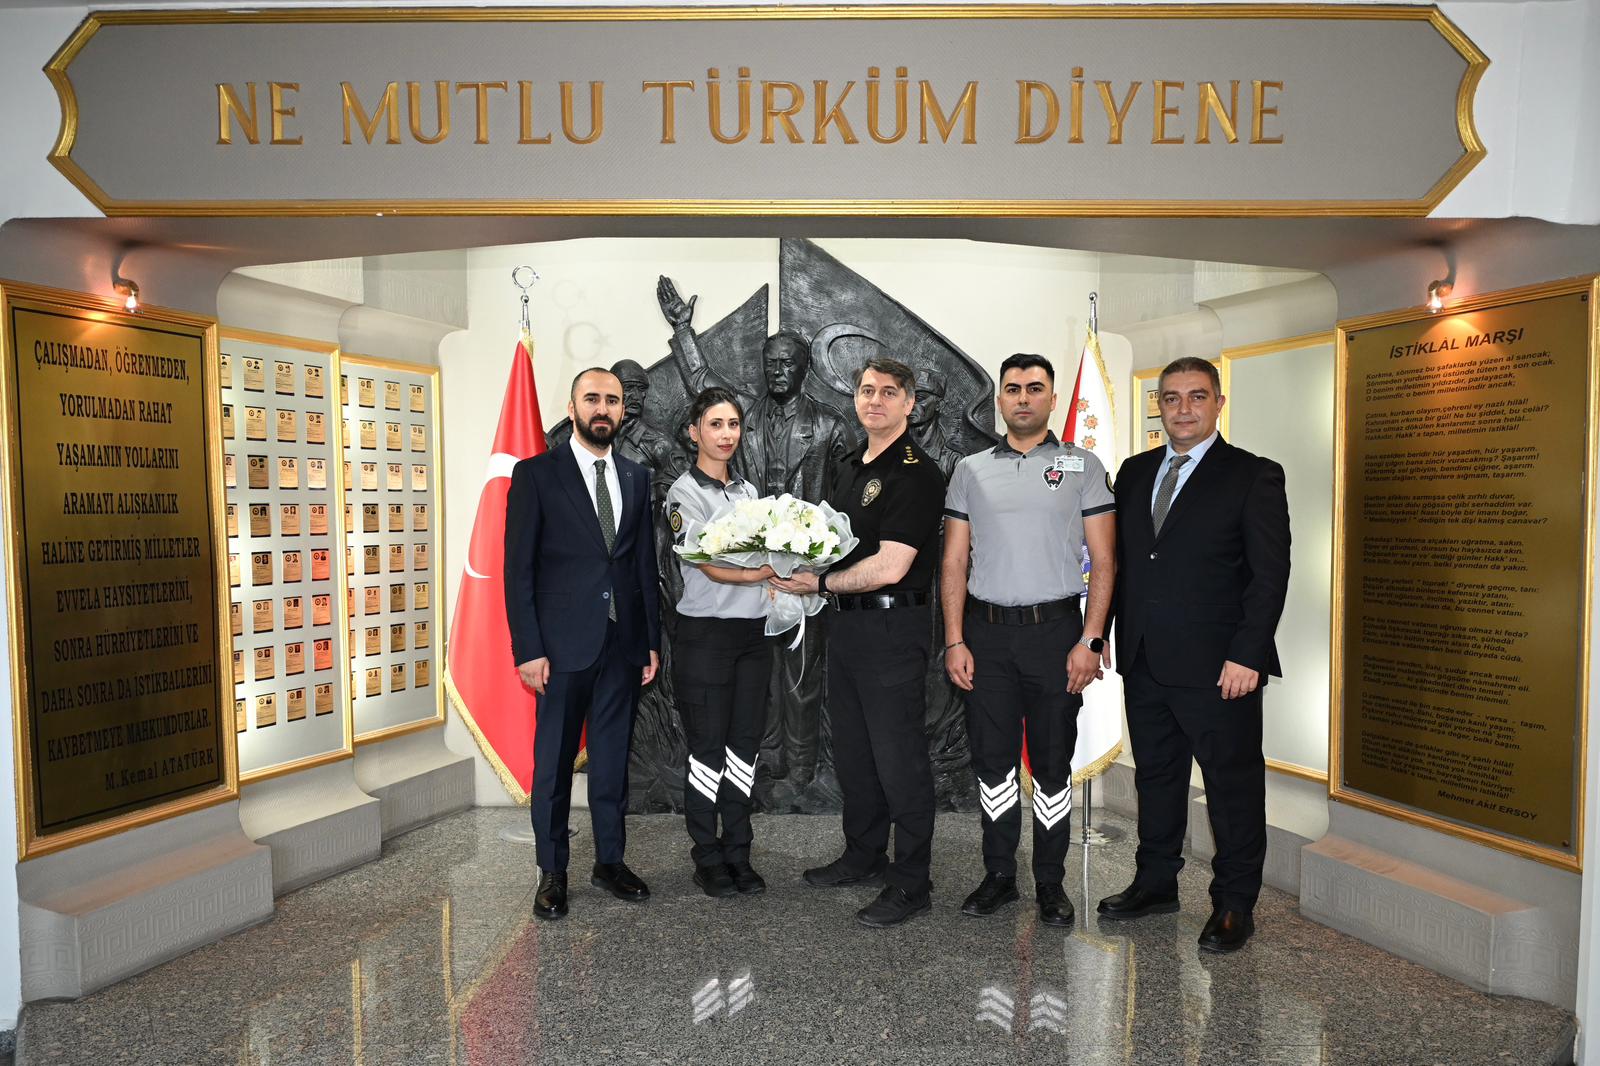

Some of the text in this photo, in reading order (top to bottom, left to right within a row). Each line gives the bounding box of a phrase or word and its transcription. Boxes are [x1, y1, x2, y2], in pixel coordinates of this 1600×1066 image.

[214, 66, 1284, 145] NE MUTLU TÜRKÜM DİYENE
[1465, 328, 1524, 348] MARŞI
[34, 340, 190, 384] ÇALIŞMADAN, ÖĞRENMEDEN,
[1516, 351, 1550, 360] sancak;
[1532, 359, 1555, 367] ocak.
[59, 393, 173, 424] YORULMADAN RAHAT
[56, 443, 179, 472] YAŞAMANIN YOLLARINI
[1501, 454, 1539, 463] Şaşarım!
[63, 492, 179, 520] ARAMAYI ALIŞKANLIK
[1478, 517, 1504, 525] kalmış
[41, 534, 201, 566] HALİNE GETİRMİŞ MİLLETLER
[56, 575, 193, 613] EVVELA HAYSİYETLERİNİ,
[1456, 582, 1484, 590] diyerek
[53, 620, 199, 663] SONRA HÜRRİYETLERİNİ VE
[1505, 630, 1528, 638] feda?
[41, 661, 212, 714] DAHA SONRA DA İSTİKBALLERİNİ
[48, 708, 211, 762] KAYBETMEYE MAHKUMDURLAR.
[105, 748, 214, 791] M.Kemal ATATÜRK
[1437, 790, 1538, 821] Mehmet Akif ERSOY
